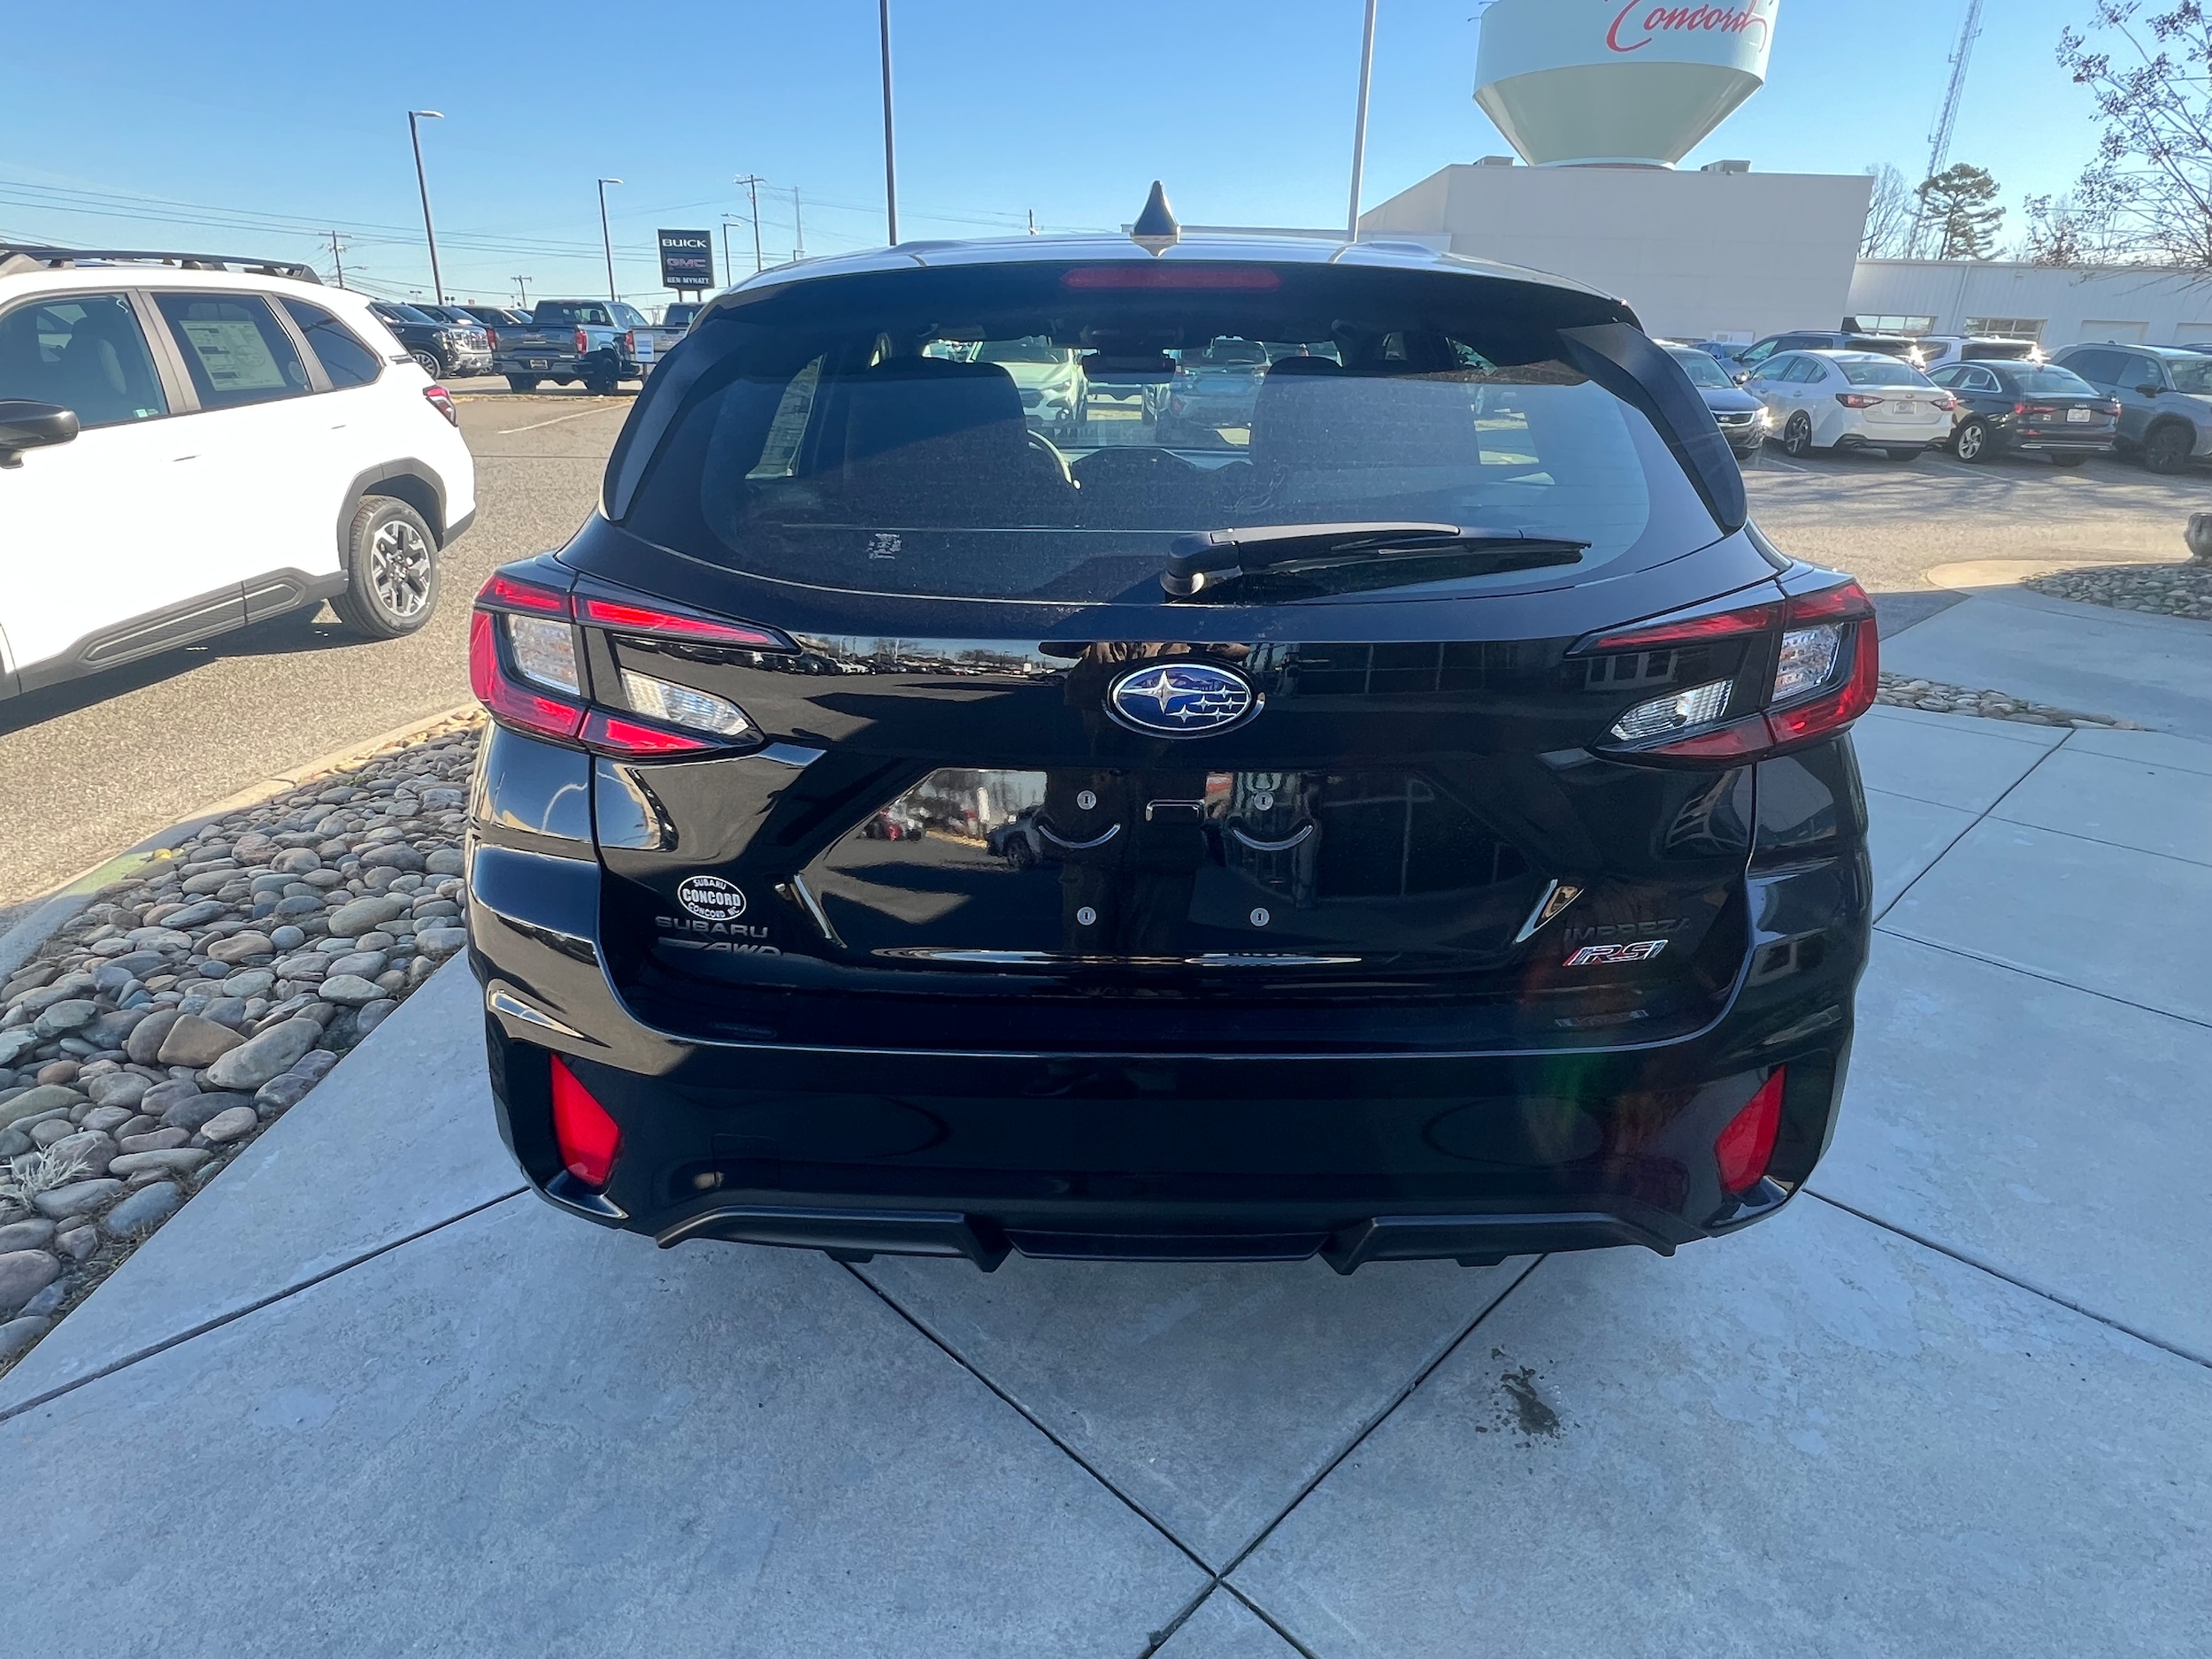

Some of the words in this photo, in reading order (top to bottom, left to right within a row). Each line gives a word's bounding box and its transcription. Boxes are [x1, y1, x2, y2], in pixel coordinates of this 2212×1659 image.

[1606, 0, 1768, 53] Concord
[662, 238, 707, 248] BUICK
[666, 257, 706, 268] GMC
[693, 878, 727, 890] SUBARU
[682, 888, 741, 907] CONCORD
[687, 902, 726, 918] CONCORD
[727, 905, 741, 917] NC
[655, 916, 769, 939] SUBARU
[703, 941, 781, 956] AWD
[1563, 939, 1670, 966] RS
